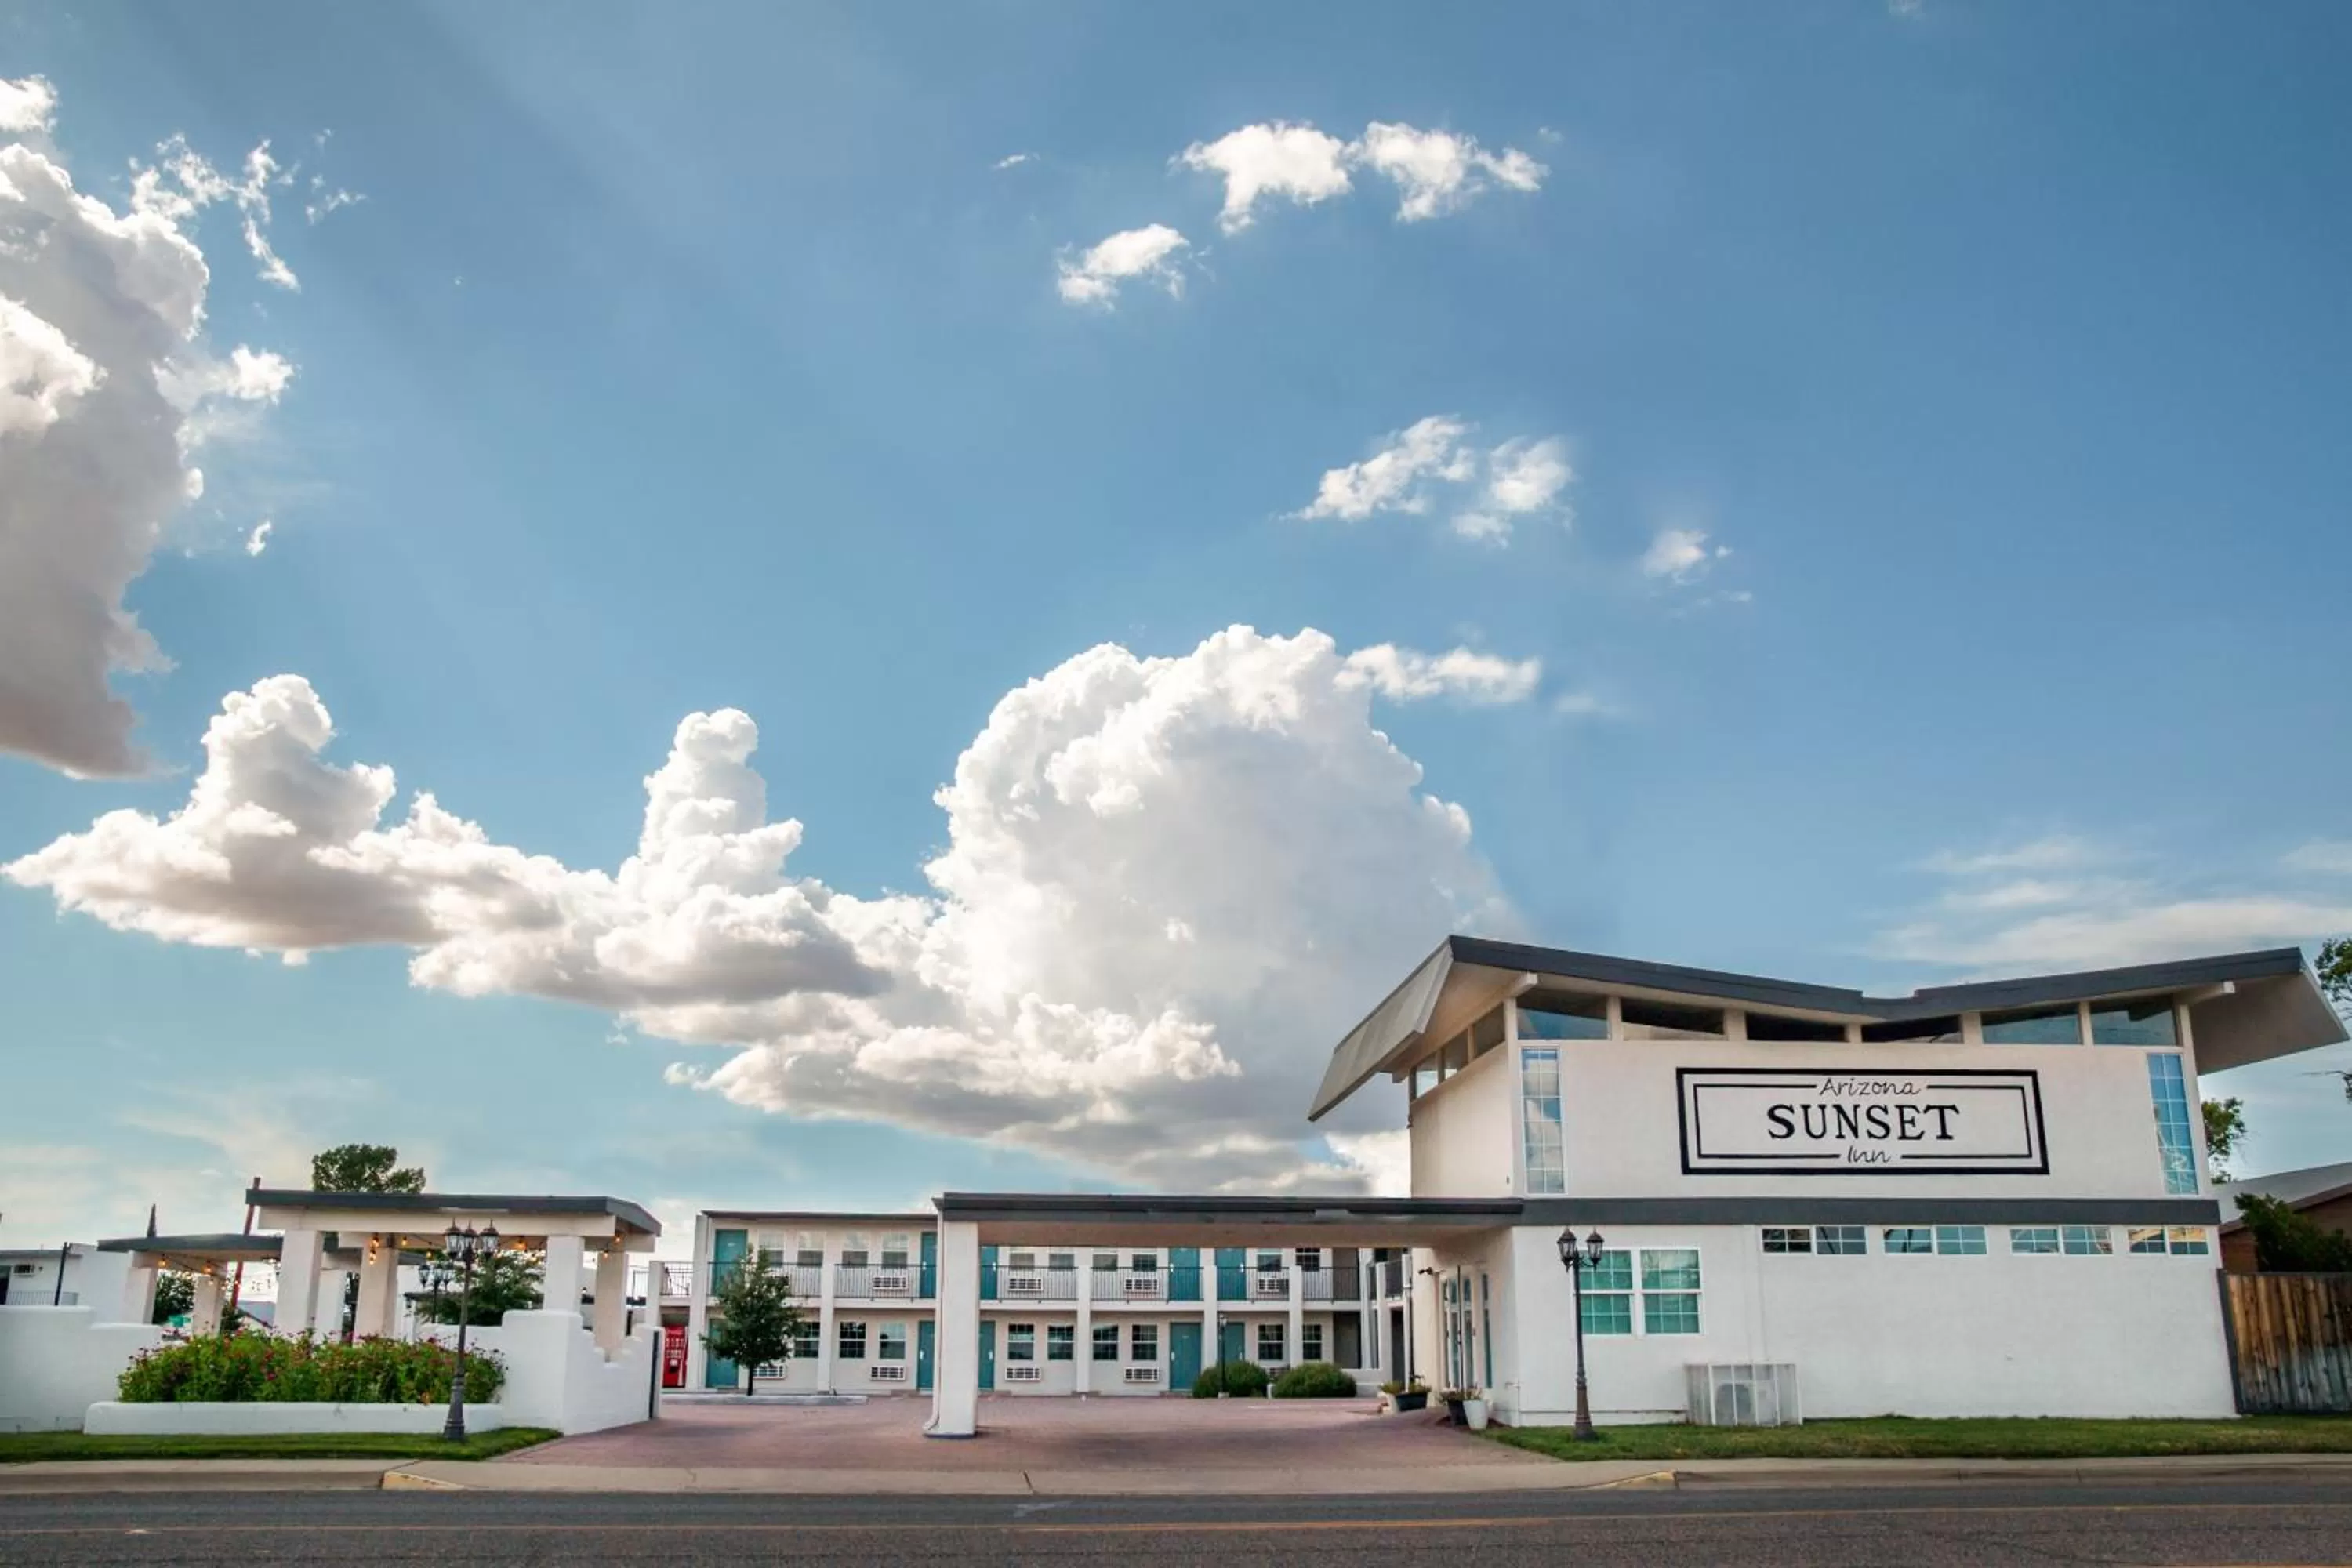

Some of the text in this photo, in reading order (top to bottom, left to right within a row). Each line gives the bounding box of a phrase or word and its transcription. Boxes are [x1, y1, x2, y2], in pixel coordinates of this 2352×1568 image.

[1820, 1077, 1921, 1096] Arizona
[1766, 1104, 1960, 1141] SUNSET
[1847, 1145, 1891, 1163] Inn
